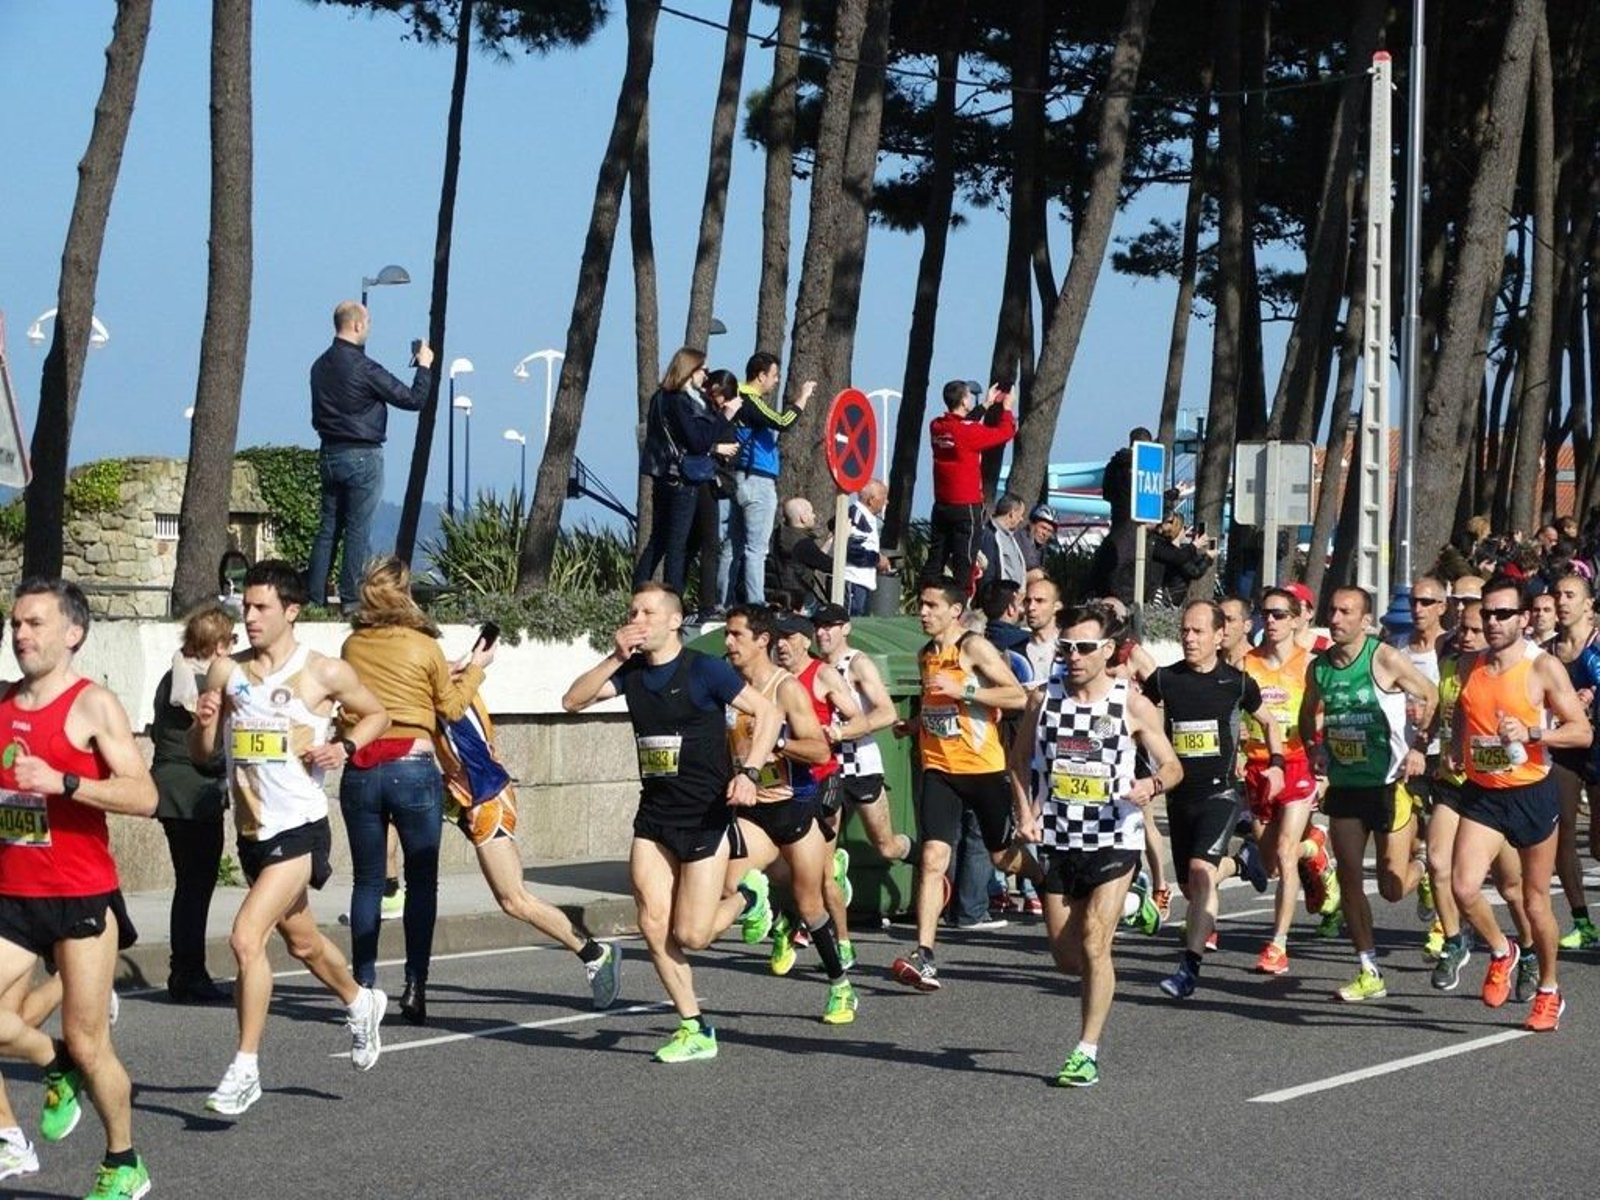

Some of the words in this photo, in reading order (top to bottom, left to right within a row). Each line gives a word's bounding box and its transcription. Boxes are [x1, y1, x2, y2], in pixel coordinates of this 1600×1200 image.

[1138, 469, 1162, 495] TAXI
[250, 733, 265, 752] 15
[1184, 733, 1205, 749] 183
[1070, 778, 1090, 796] 34
